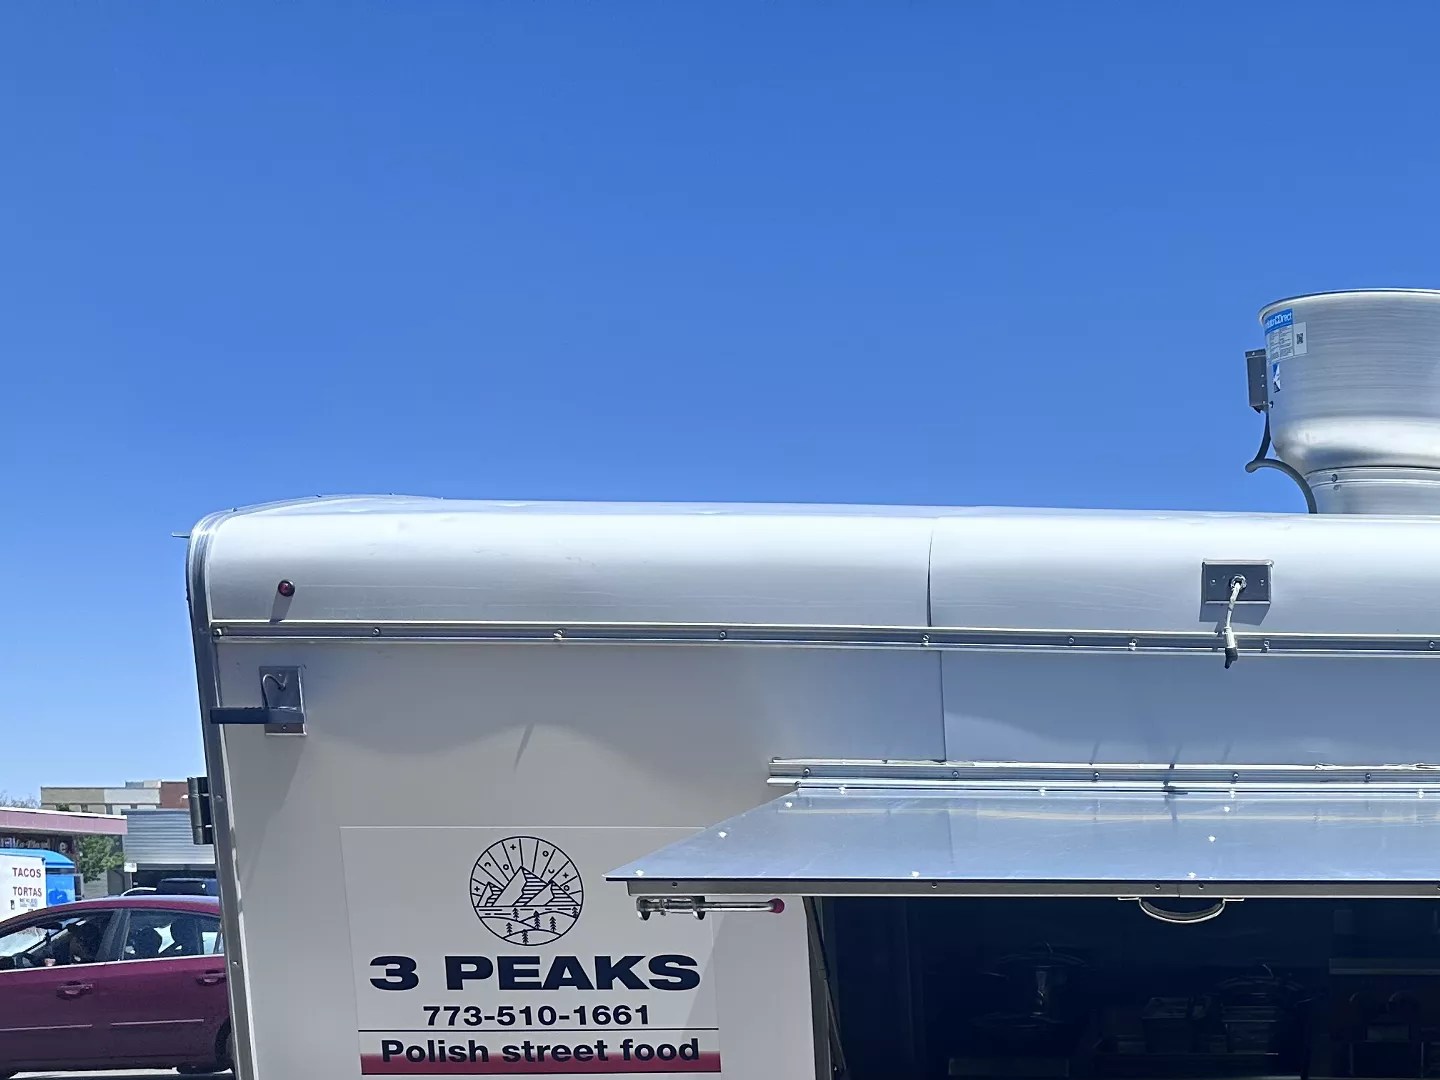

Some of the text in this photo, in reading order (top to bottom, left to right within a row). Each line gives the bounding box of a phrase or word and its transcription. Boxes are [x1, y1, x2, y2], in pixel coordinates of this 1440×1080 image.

[12, 867, 42, 878] TACOS
[12, 886, 43, 897] TORTAS
[369, 954, 701, 991] 3 PEAKS
[423, 1005, 649, 1027] 773-510-1661
[381, 1038, 699, 1063] Polish street food
